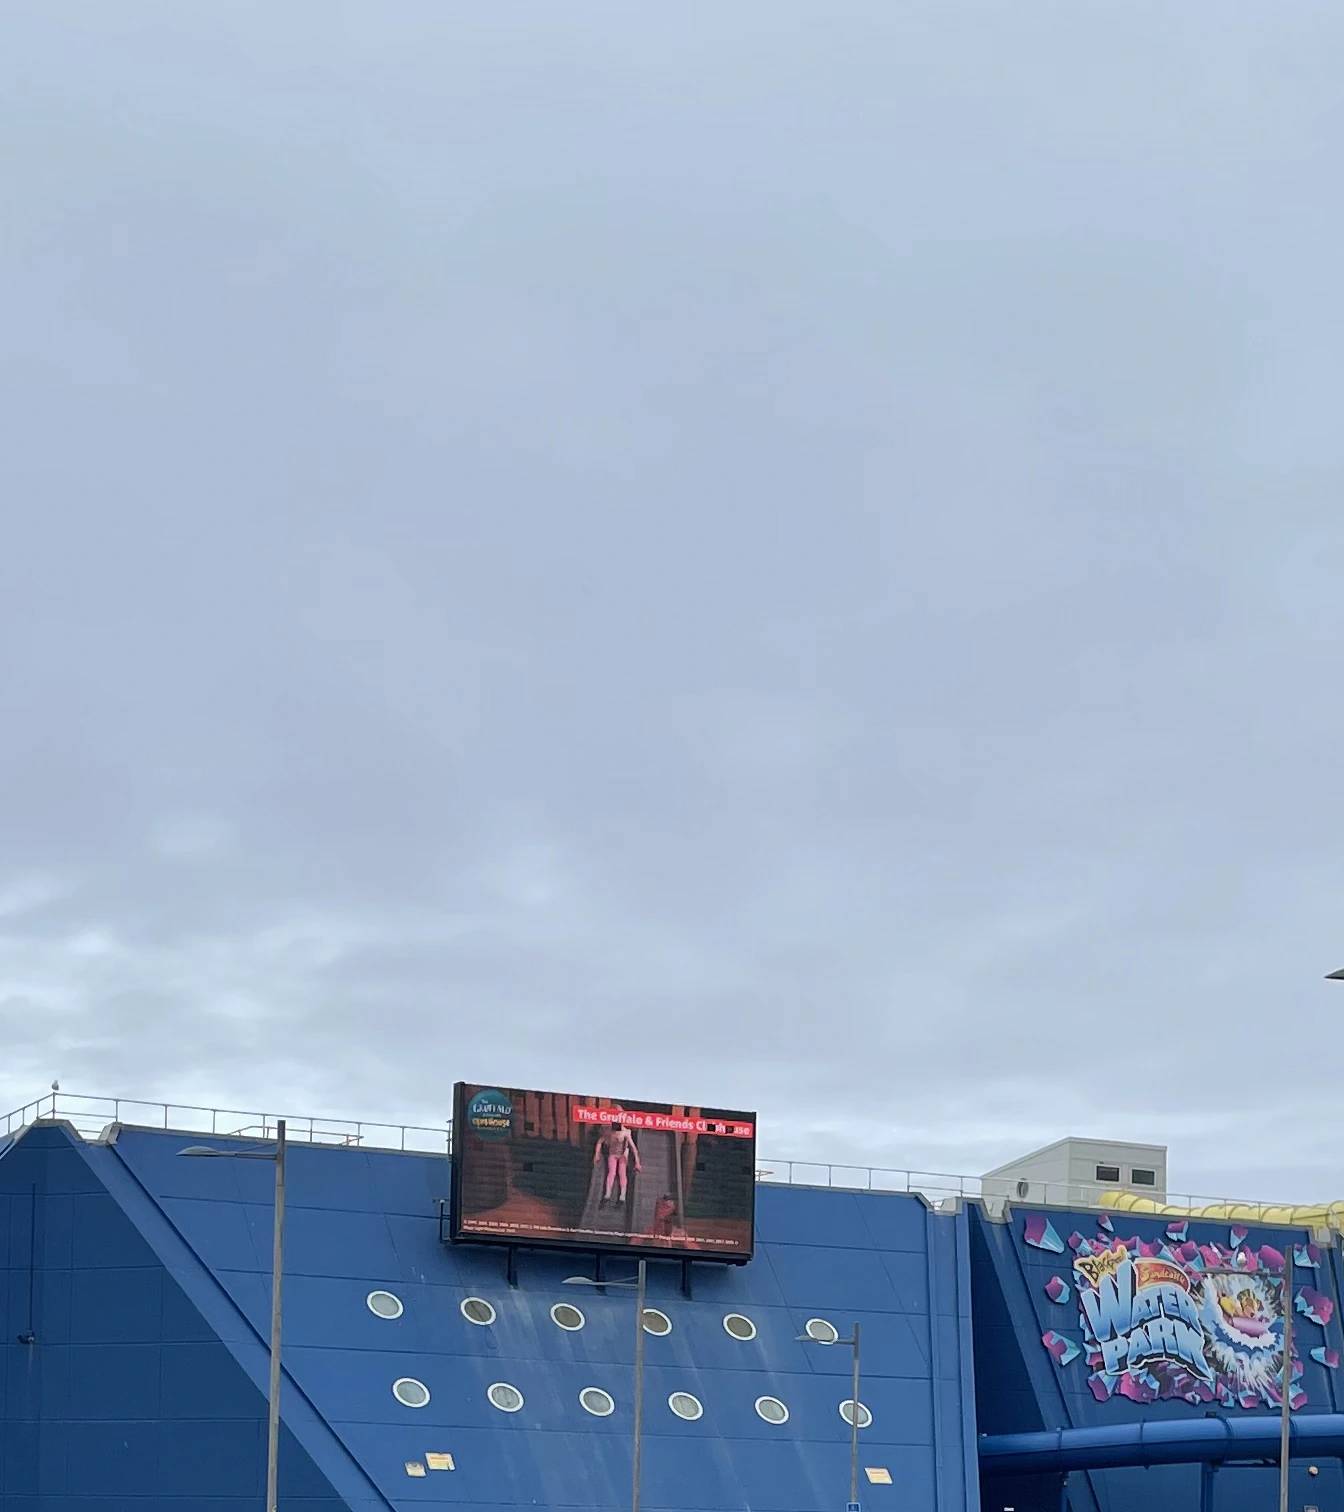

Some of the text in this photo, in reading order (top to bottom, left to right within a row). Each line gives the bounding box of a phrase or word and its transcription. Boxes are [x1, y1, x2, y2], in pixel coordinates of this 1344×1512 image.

[578, 1109, 597, 1121] The
[599, 1110, 643, 1125] Gruffalo
[645, 1116, 653, 1126] &
[656, 1117, 694, 1130] Friends
[1081, 1259, 1204, 1342] WATER
[1101, 1318, 1213, 1380] PARK
